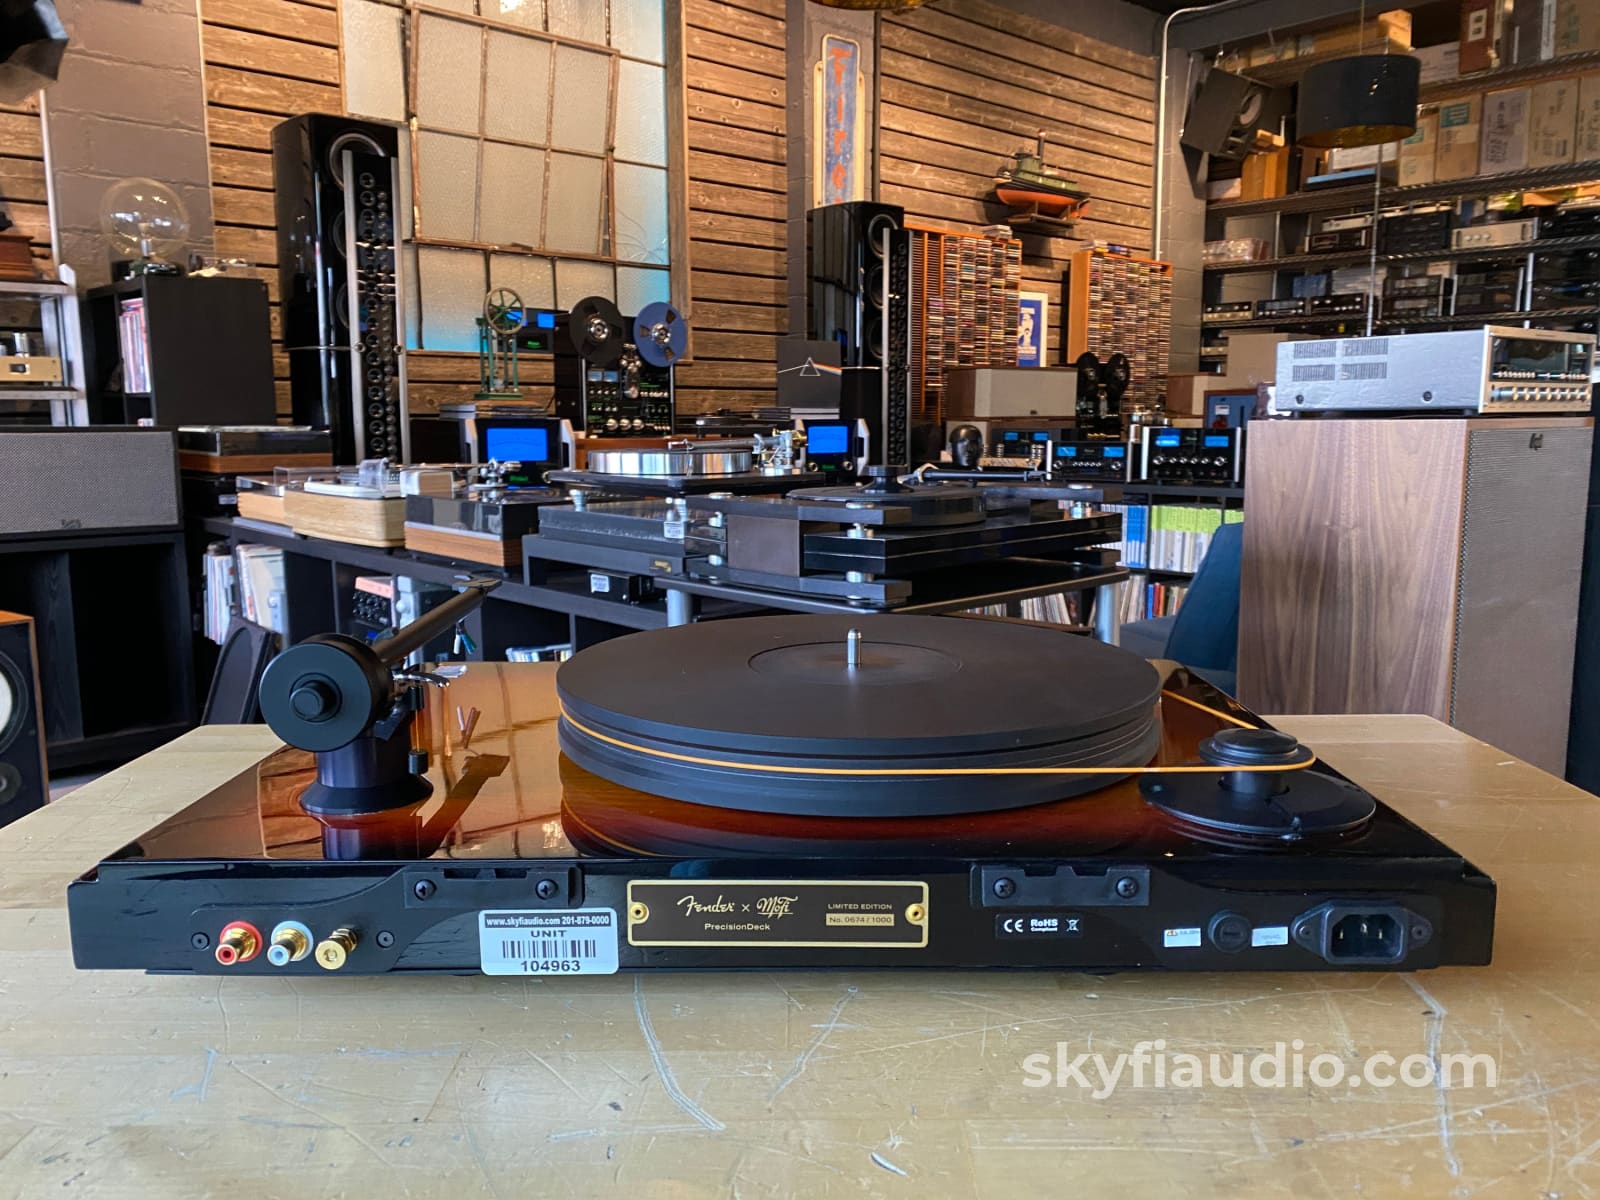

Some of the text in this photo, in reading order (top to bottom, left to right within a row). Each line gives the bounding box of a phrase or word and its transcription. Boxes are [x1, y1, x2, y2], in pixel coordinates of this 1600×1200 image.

[829, 47, 852, 204] Fire
[677, 895, 735, 917] Fender
[486, 917, 561, 927] www.skyfiaudio.com
[704, 923, 771, 931] PrecisionDeck
[1030, 918, 1059, 927] RoHS
[530, 930, 567, 938] UNIT
[520, 960, 581, 972] 104963
